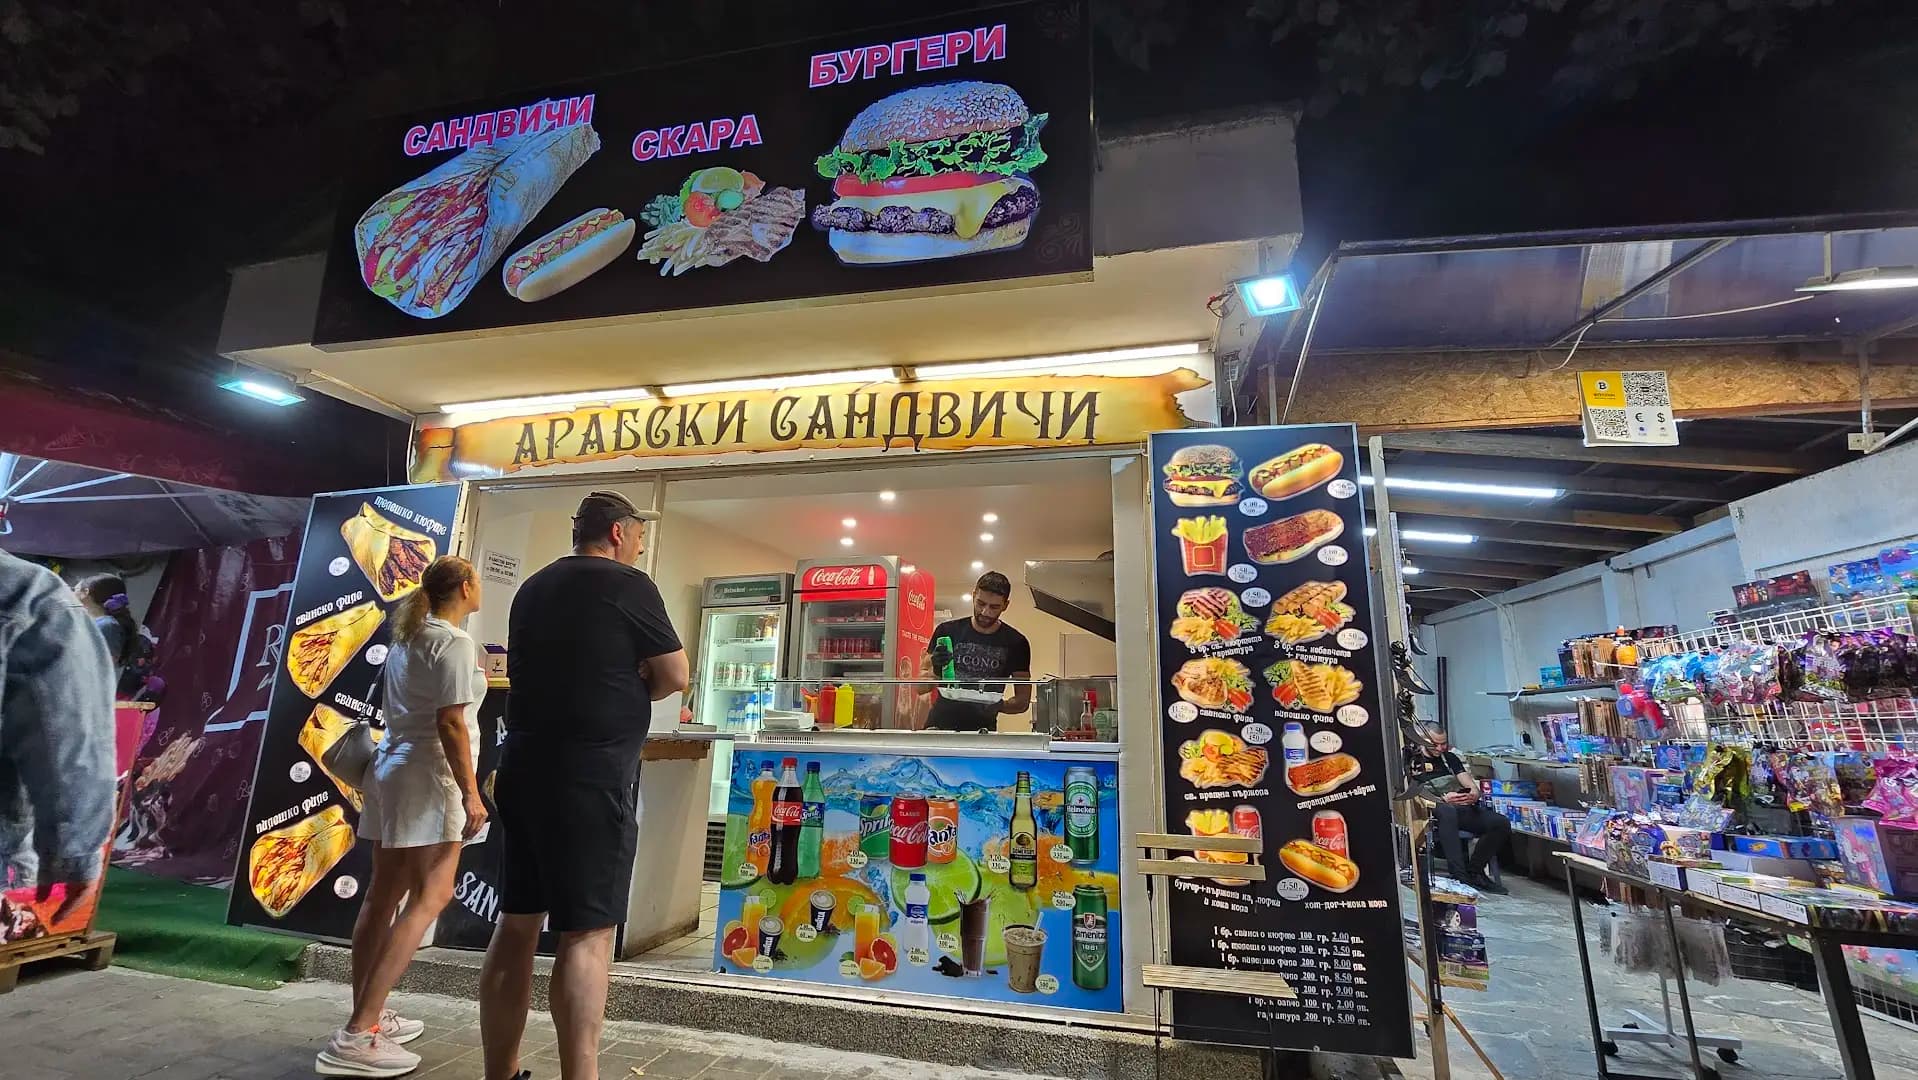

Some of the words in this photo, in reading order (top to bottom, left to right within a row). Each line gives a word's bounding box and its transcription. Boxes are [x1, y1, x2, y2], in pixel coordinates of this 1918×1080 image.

[809, 24, 1006, 88] БУРГЕРИ
[403, 94, 595, 156] САНДВИЧИ
[631, 114, 762, 162] СКАРА
[512, 397, 749, 465] АРАБСКИ
[770, 391, 1100, 454] САНДВИЧИ
[374, 496, 413, 520] телешко
[413, 513, 447, 536] кюфте
[811, 567, 863, 586] Coca-Cola
[296, 602, 333, 626] свинско
[336, 590, 363, 611] филе
[1200, 709, 1231, 720] свинско
[1274, 710, 1310, 721] пилешко
[256, 805, 299, 834] пилешко
[302, 790, 328, 814] филе
[928, 825, 957, 846] anta
[453, 871, 502, 923] SAN
[1220, 926, 1232, 938] бр.
[1267, 932, 1296, 941] кюфте
[1317, 934, 1329, 944] гр.
[1217, 939, 1229, 951] бр.
[1268, 945, 1297, 955] кюфте
[1318, 948, 1330, 957] гр.
[1227, 953, 1239, 965] бр.
[1319, 961, 1331, 971] гр.
[1320, 974, 1332, 984] гр.
[1321, 988, 1333, 998] гр.
[1269, 999, 1300, 1007] кбапче
[1322, 1002, 1334, 1012] гр.
[1323, 1015, 1335, 1025] гр.
